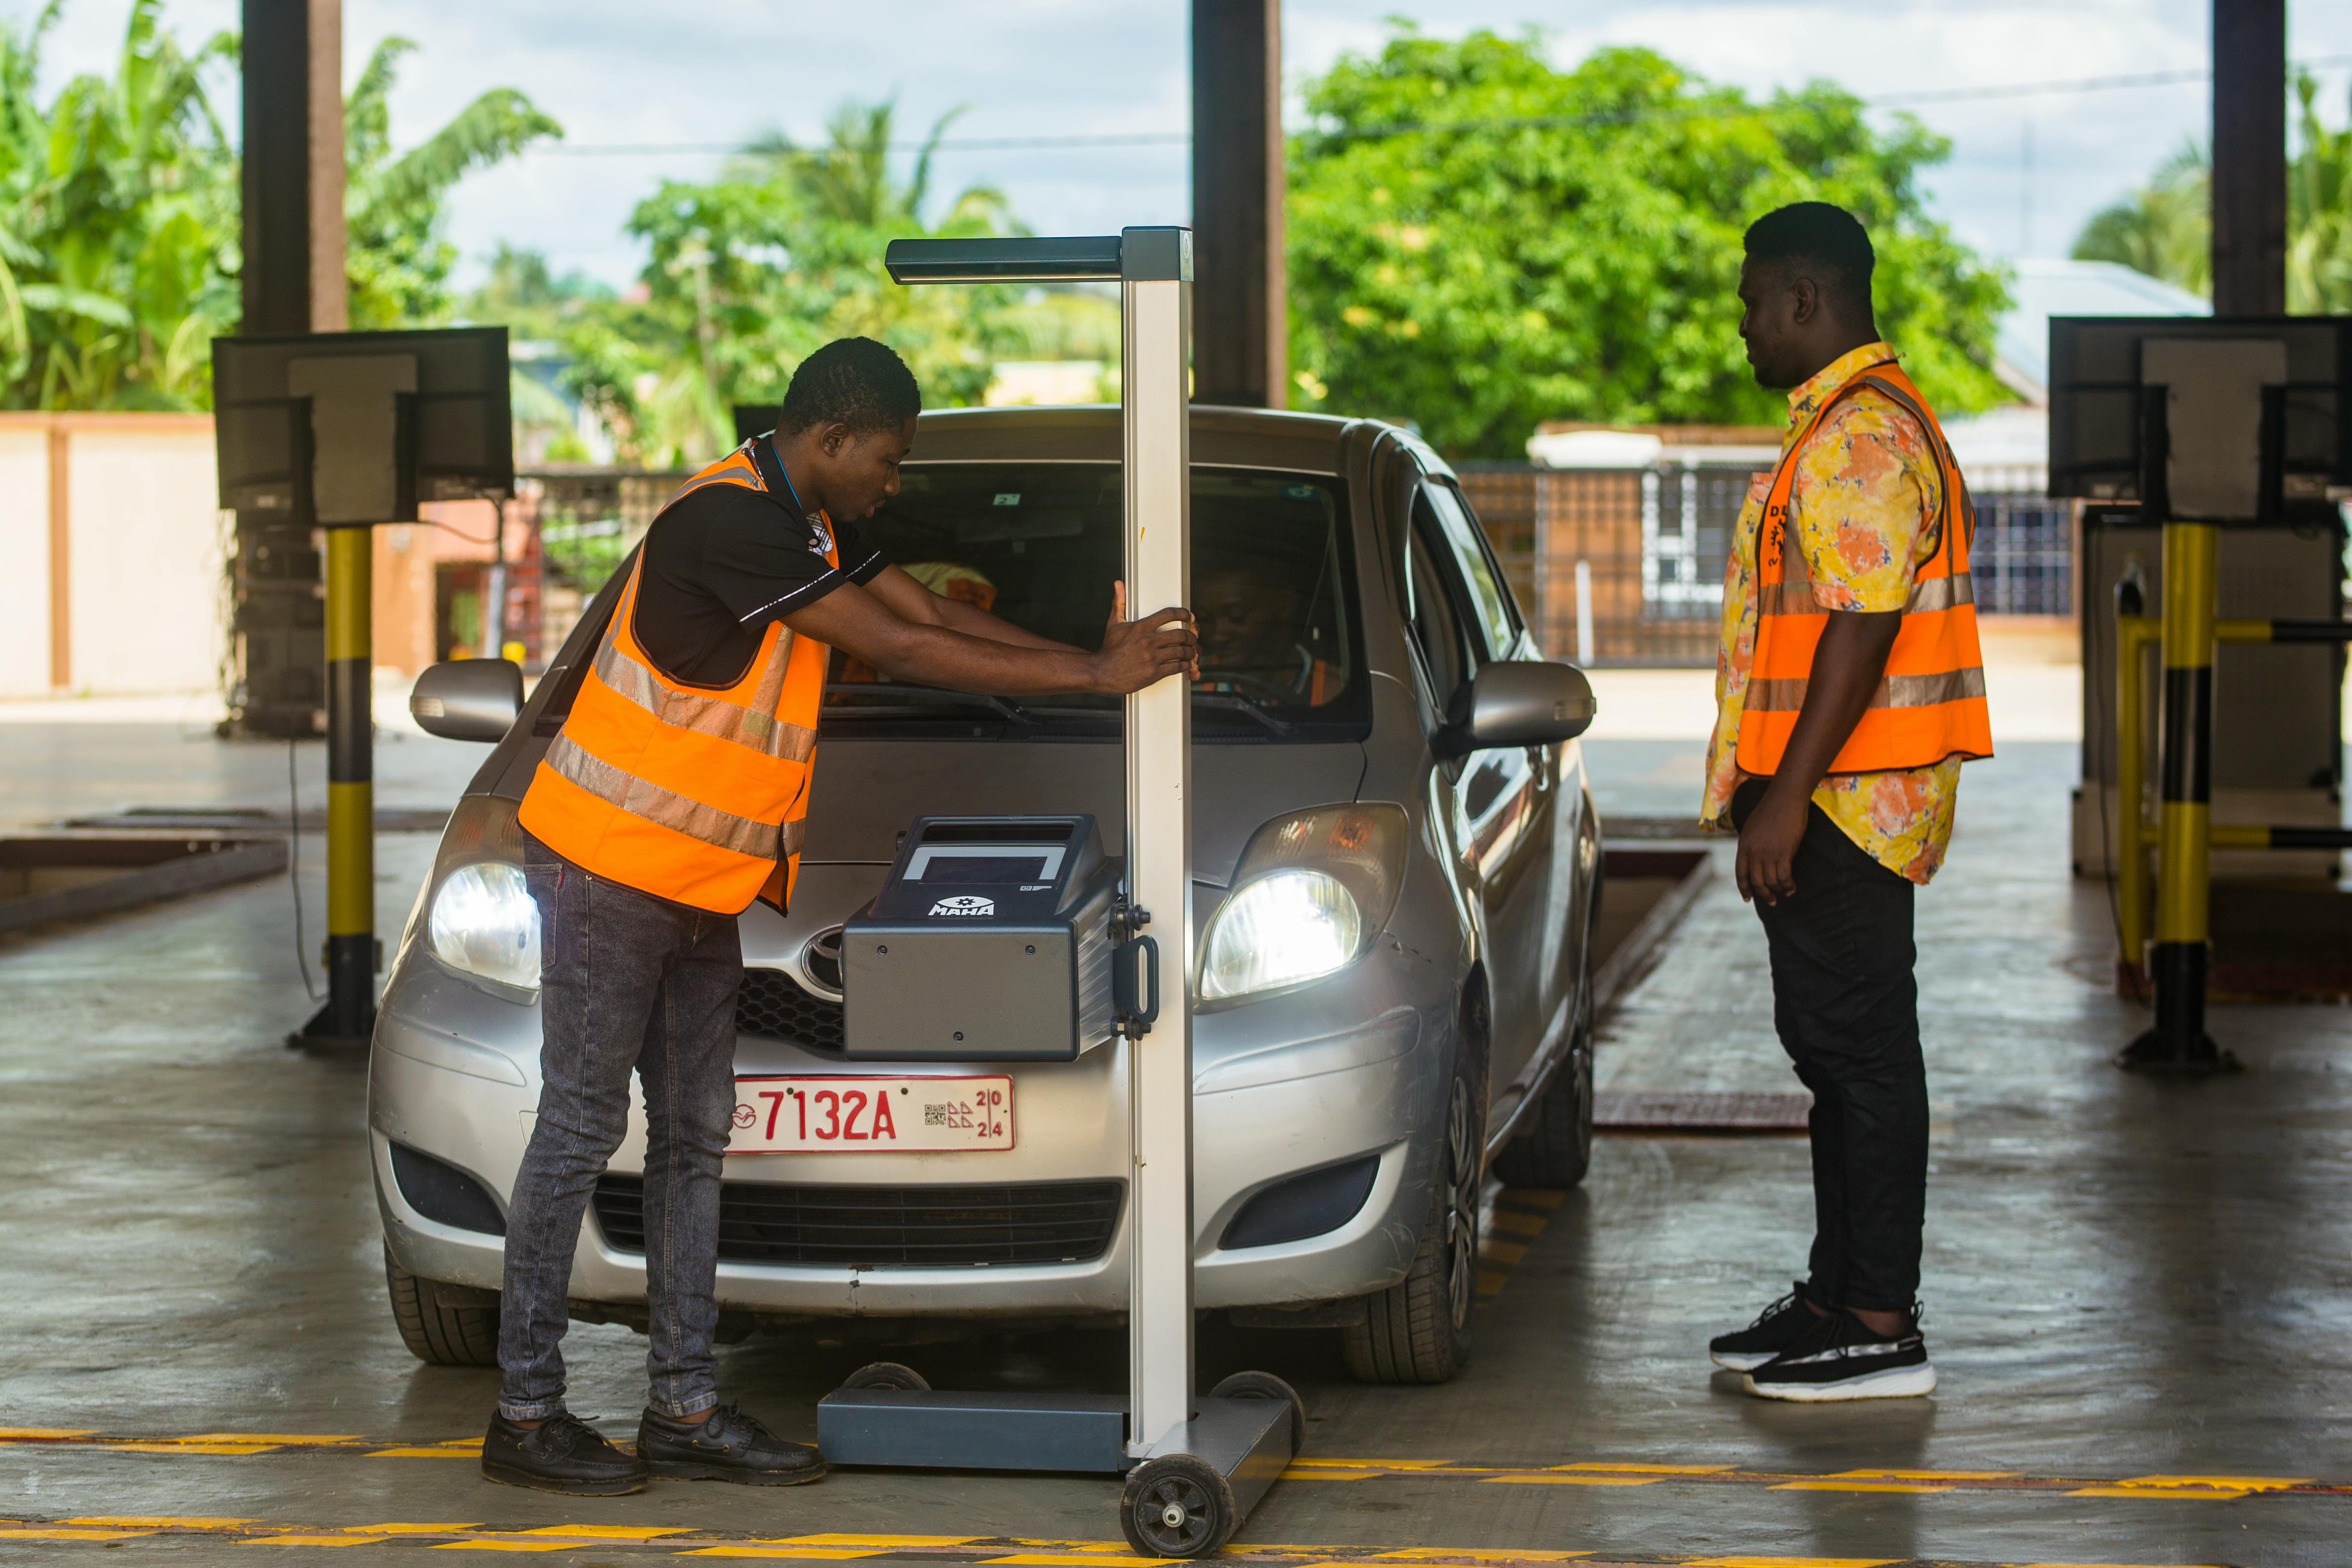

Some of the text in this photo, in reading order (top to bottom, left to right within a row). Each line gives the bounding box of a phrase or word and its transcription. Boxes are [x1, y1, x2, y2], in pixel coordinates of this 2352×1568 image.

[928, 904, 994, 916] MAHA
[976, 1090, 1001, 1106] 20
[759, 1090, 896, 1140] 7132A
[978, 1121, 1002, 1137] 24
